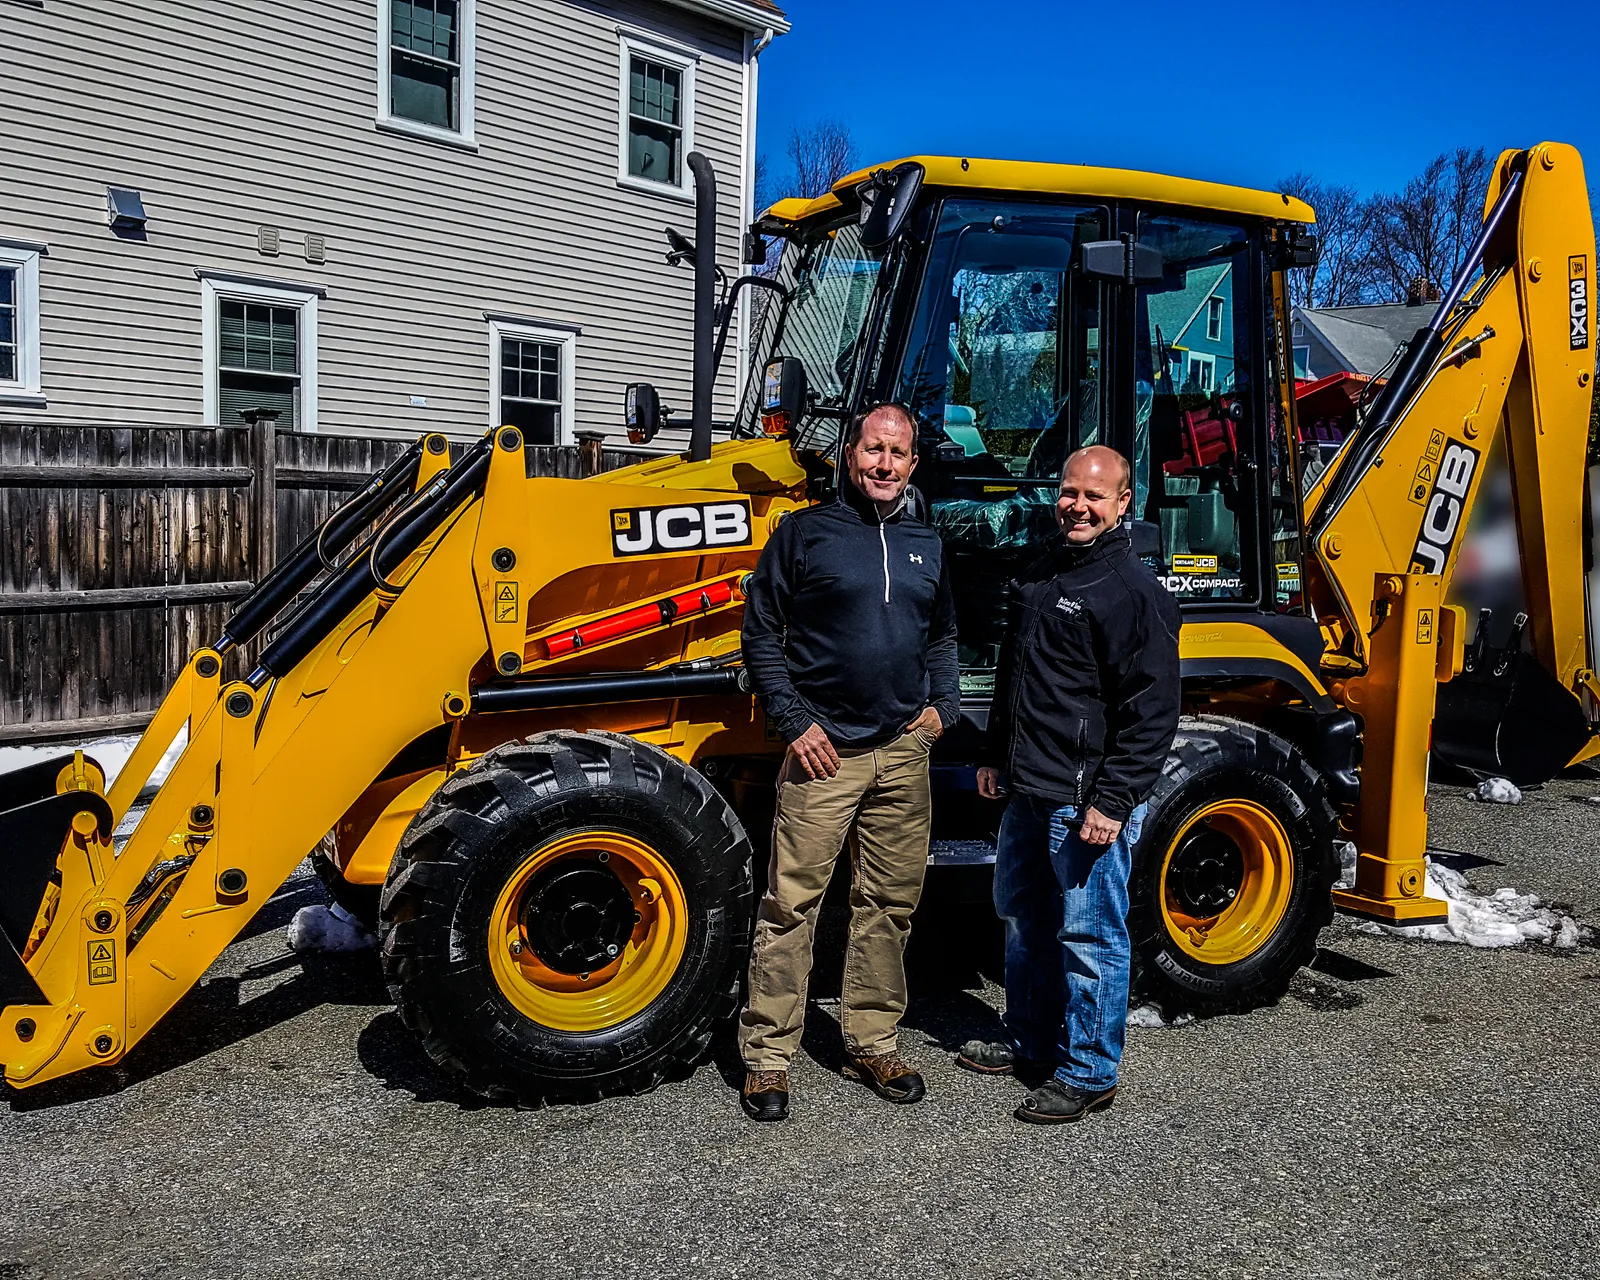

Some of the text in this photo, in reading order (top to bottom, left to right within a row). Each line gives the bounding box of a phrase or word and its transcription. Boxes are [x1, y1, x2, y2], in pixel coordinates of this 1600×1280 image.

[1571, 280, 1587, 335] 3CX
[615, 504, 749, 552] JCB
[1416, 445, 1475, 575] JCB
[1192, 578, 1240, 588] COMPACT
[1196, 558, 1216, 567] JCB
